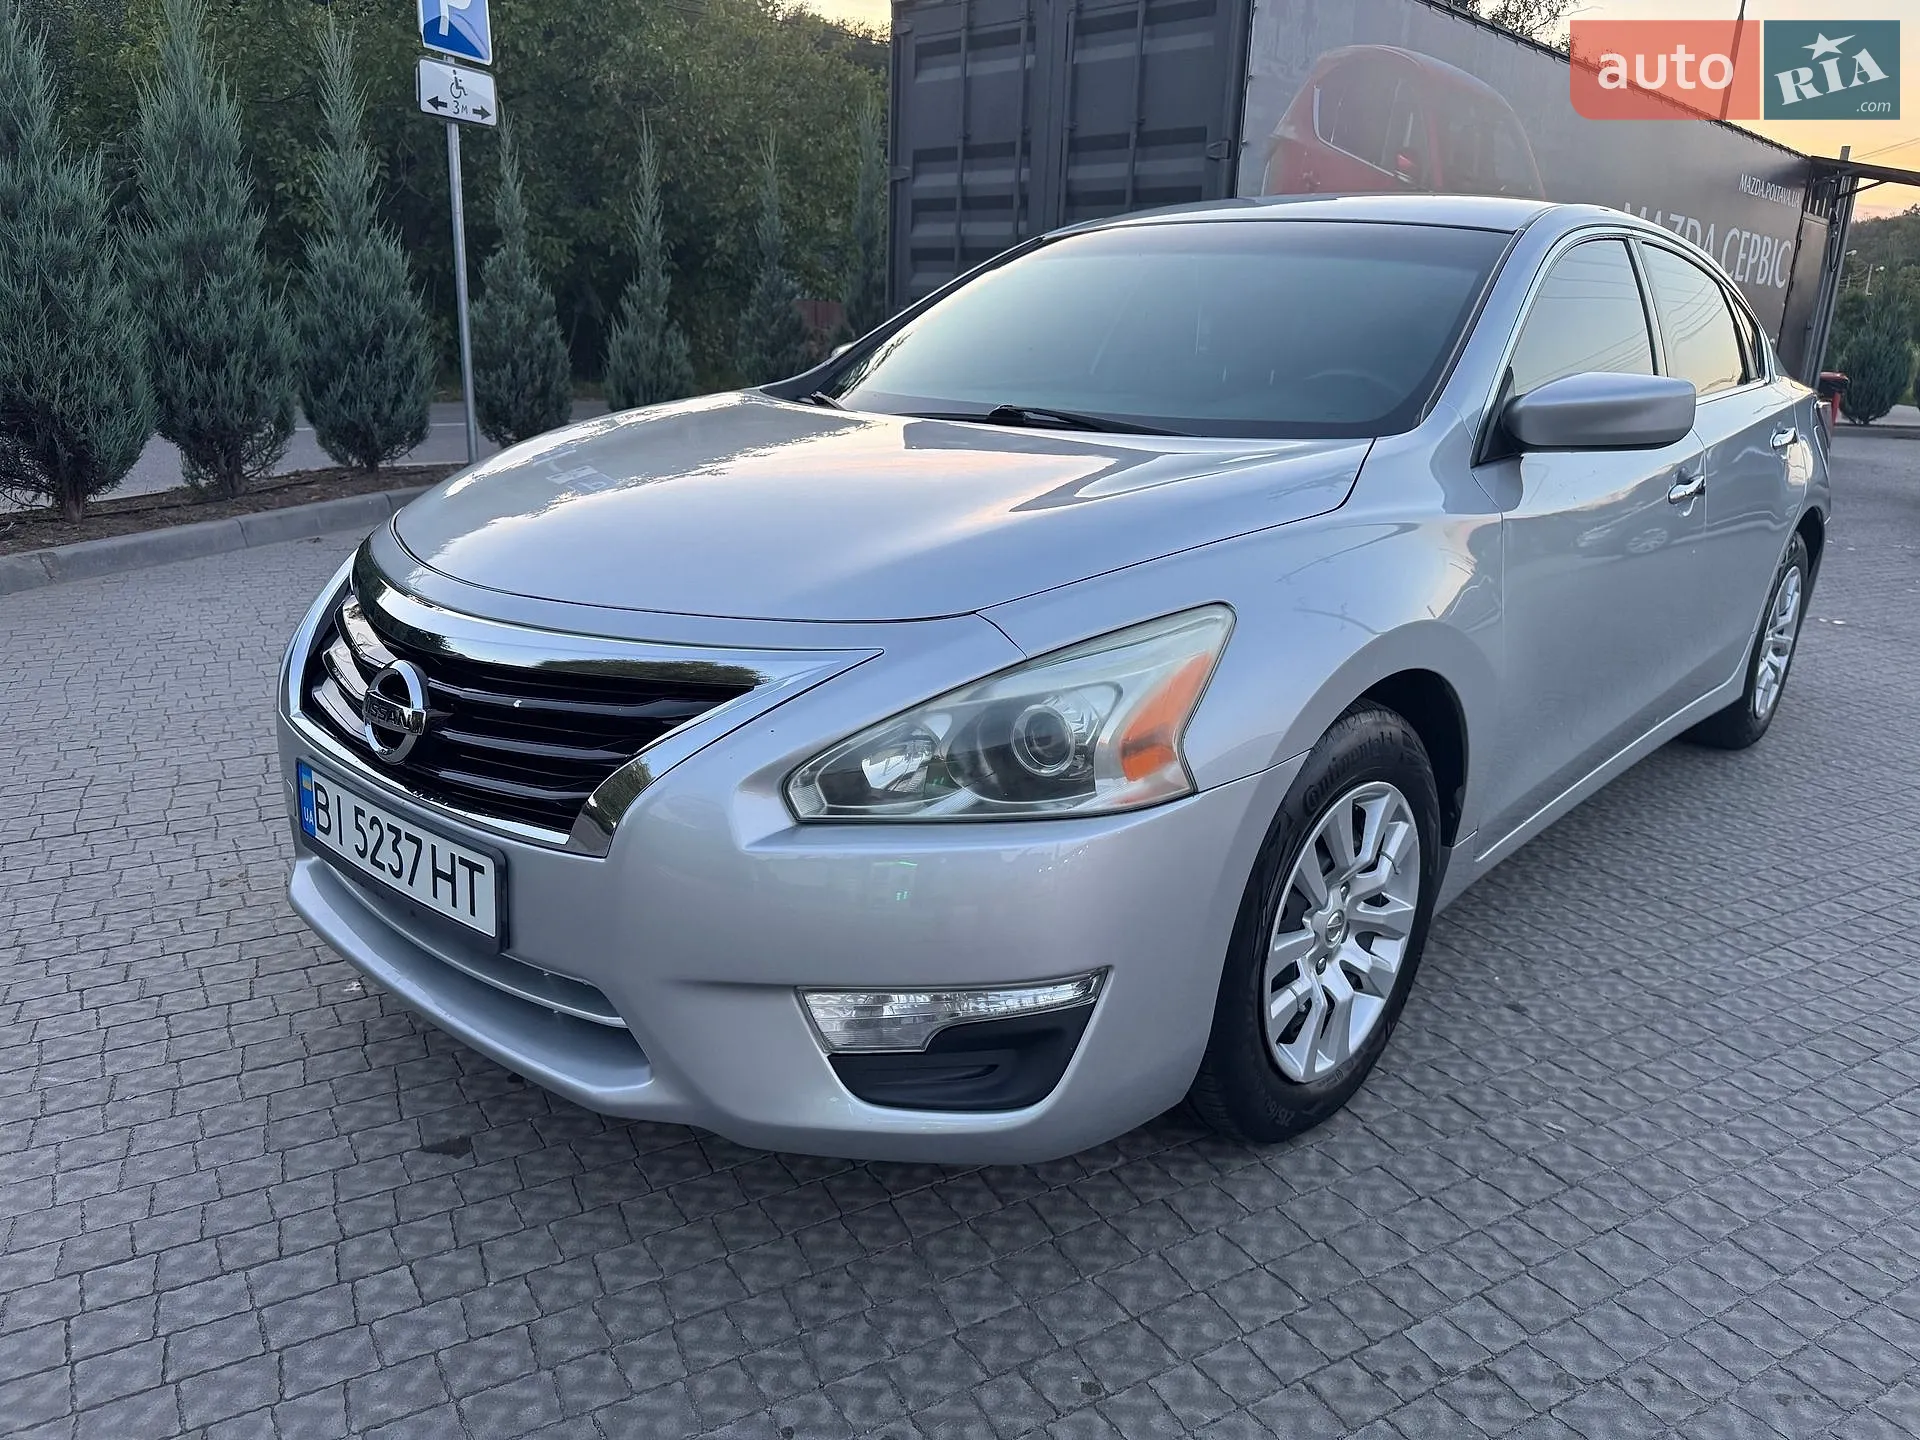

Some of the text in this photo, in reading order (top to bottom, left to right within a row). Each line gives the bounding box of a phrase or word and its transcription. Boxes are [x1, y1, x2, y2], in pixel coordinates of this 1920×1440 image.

[303, 806, 314, 826] UA
[312, 783, 485, 918] BI 5237 HT
